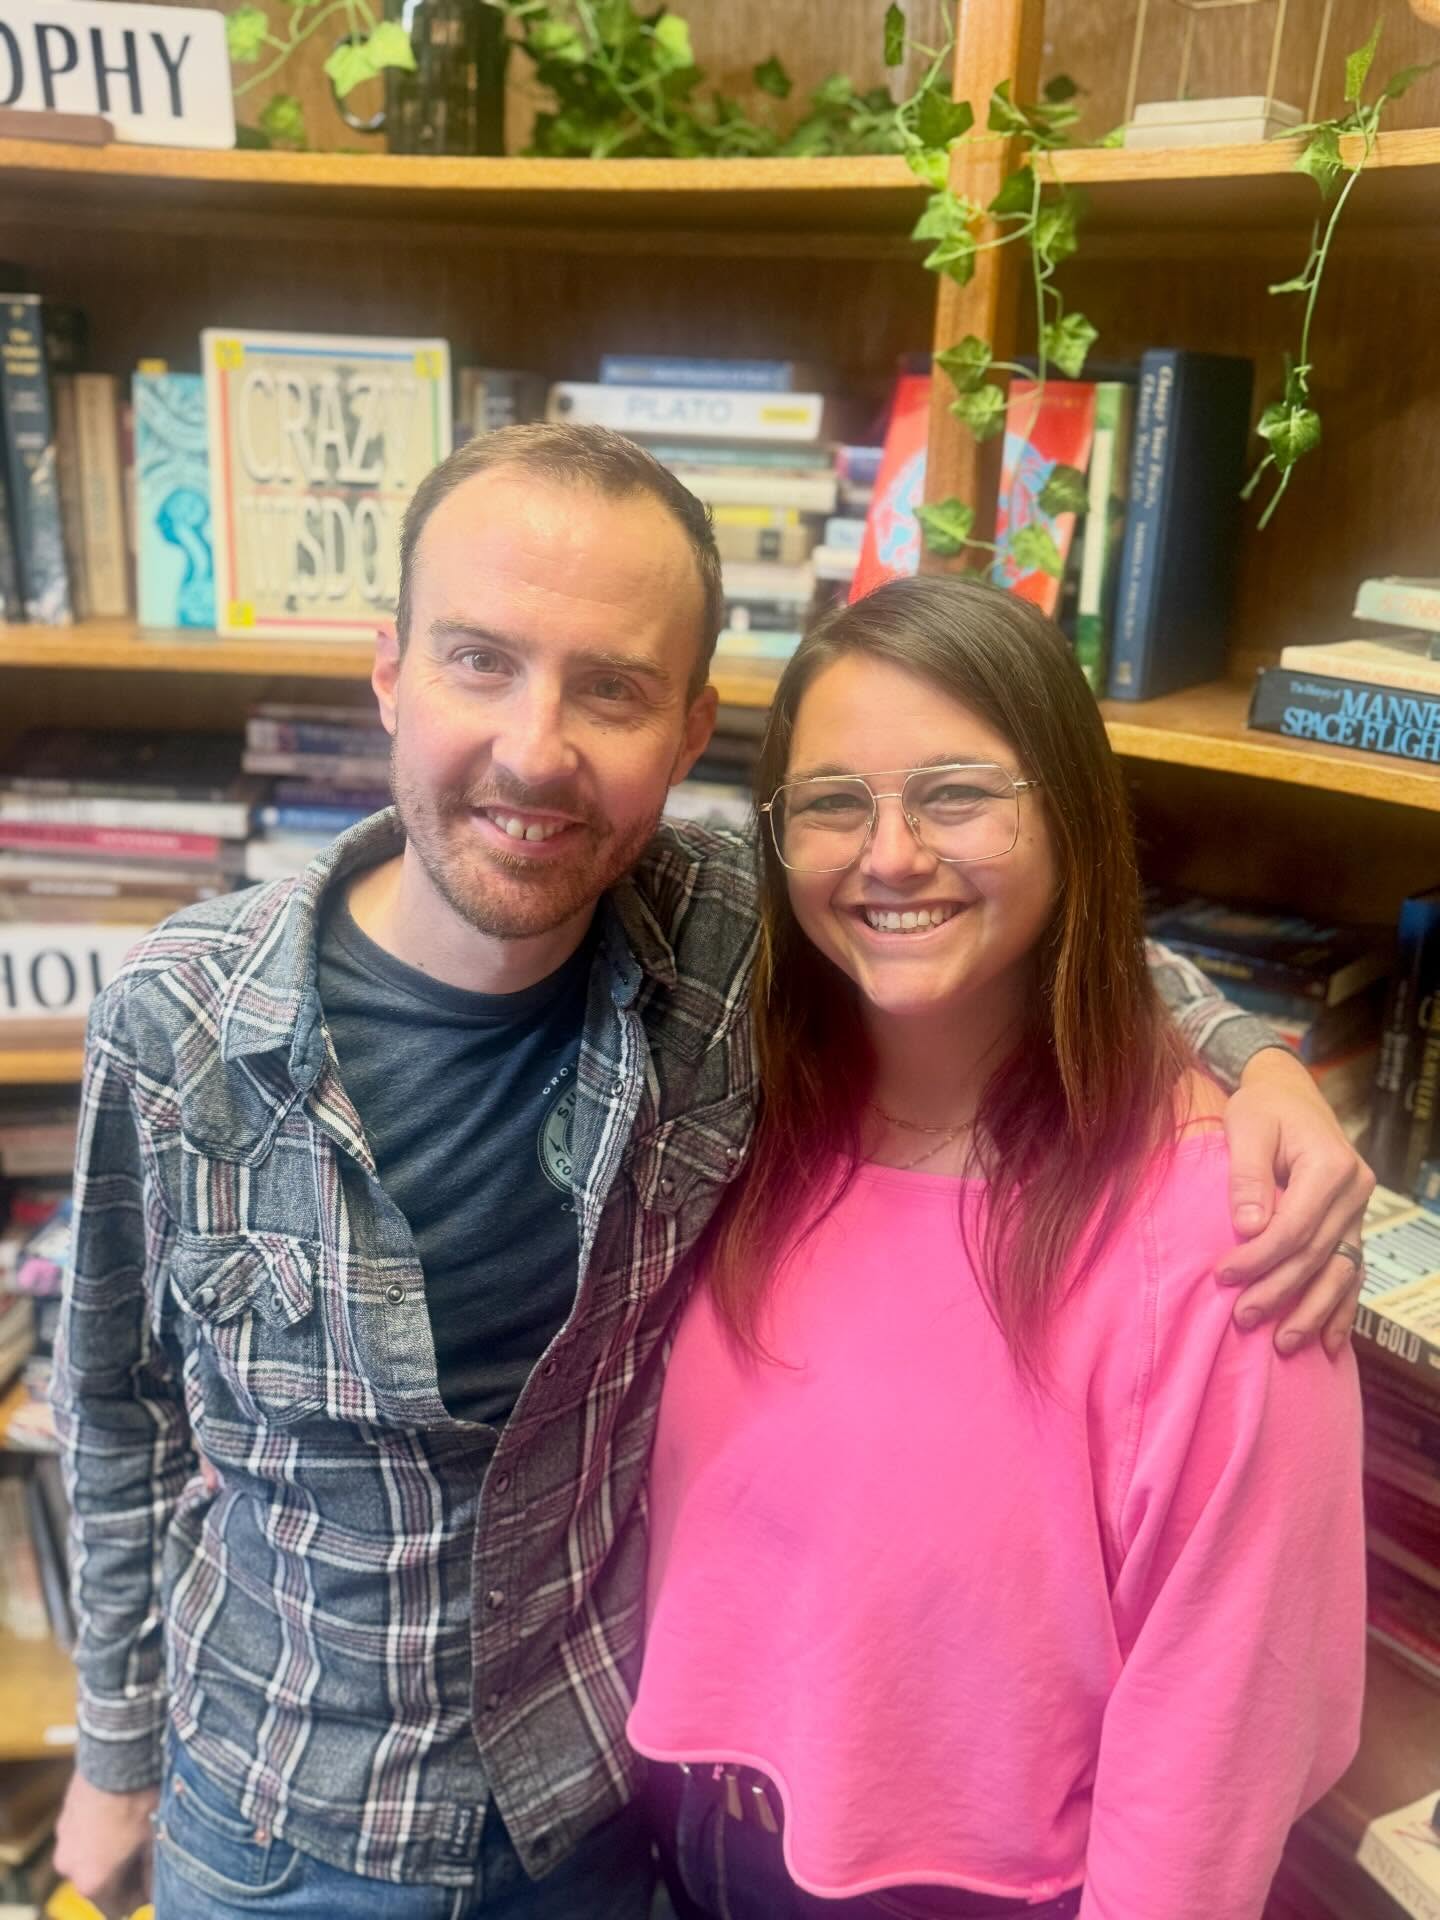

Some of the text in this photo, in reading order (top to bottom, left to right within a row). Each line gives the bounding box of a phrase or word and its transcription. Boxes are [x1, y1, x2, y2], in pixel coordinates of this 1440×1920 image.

[626, 394, 735, 425] PLATO
[1280, 705, 1440, 761] SPACE FLIGH
[1376, 1318, 1421, 1364] GOLD
